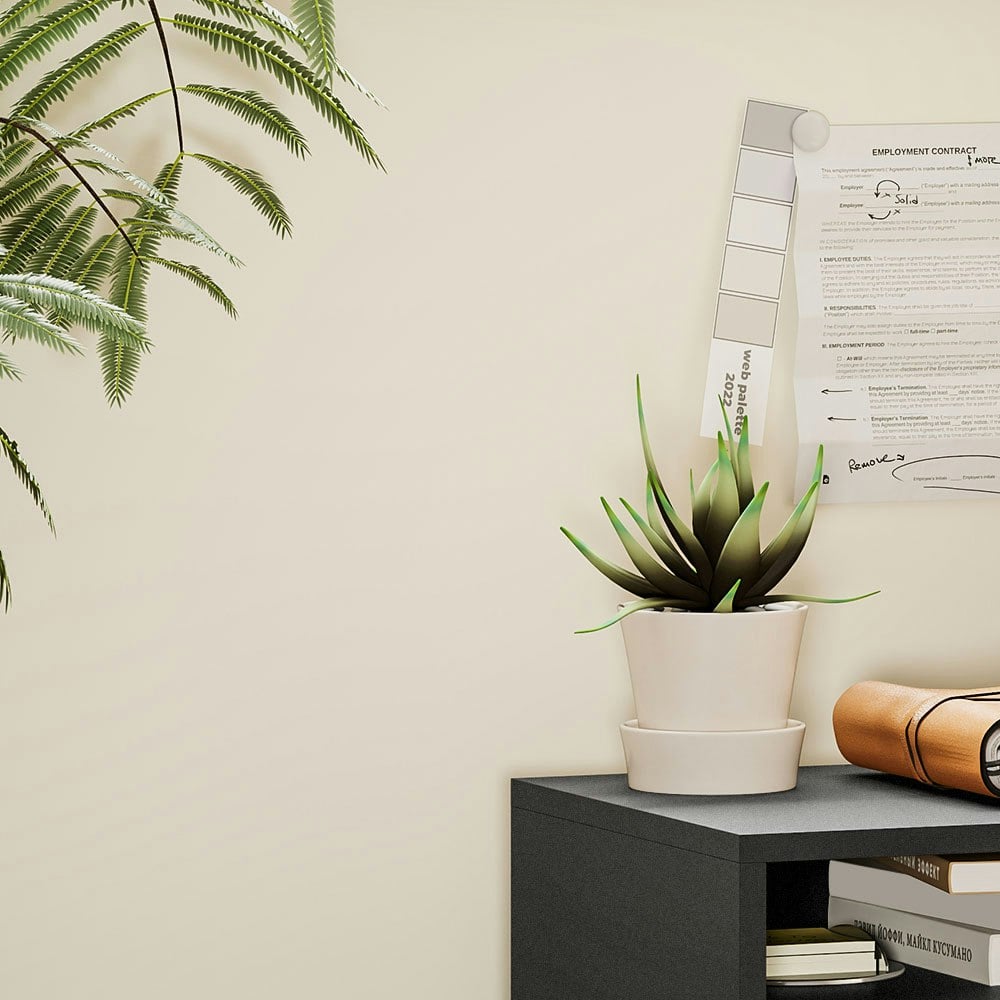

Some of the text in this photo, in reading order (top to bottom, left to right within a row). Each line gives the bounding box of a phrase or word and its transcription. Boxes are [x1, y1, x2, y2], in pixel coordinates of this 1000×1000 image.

[872, 147, 977, 157] EMPLOYMENT CONTRACT
[723, 373, 735, 407] 2022
[734, 350, 752, 436] web palette
[918, 858, 940, 881] ЭФФЕКТ
[907, 932, 931, 953] МАЙКЛ
[933, 940, 973, 962] КУСУМАНО
